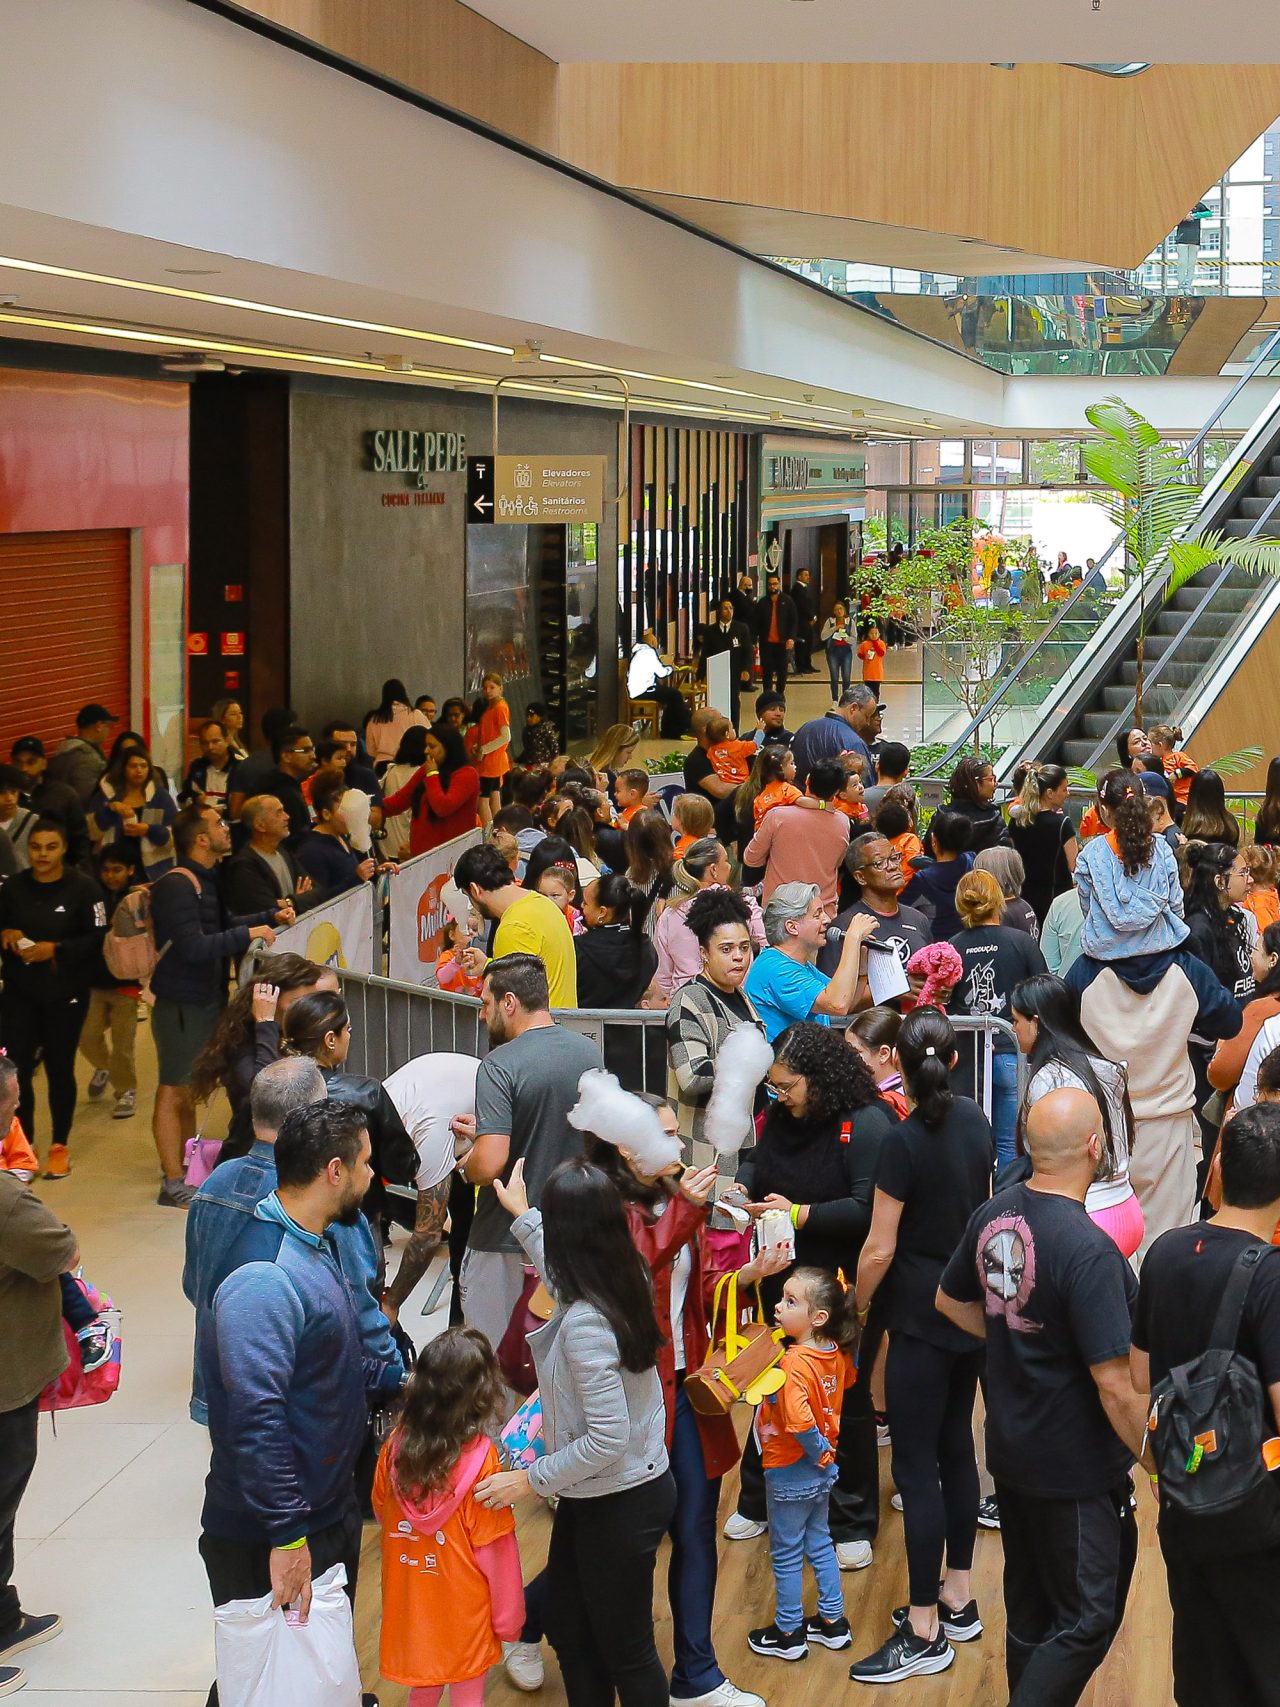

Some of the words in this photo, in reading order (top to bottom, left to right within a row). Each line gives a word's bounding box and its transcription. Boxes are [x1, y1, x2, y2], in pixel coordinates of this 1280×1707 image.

[374, 430, 419, 472] SALE
[424, 431, 467, 472] PEPE
[542, 469, 591, 477] Elevadores
[542, 480, 582, 488] Elevators
[542, 497, 586, 505] Sanitários
[965, 944, 999, 955] PRODUÇÃO
